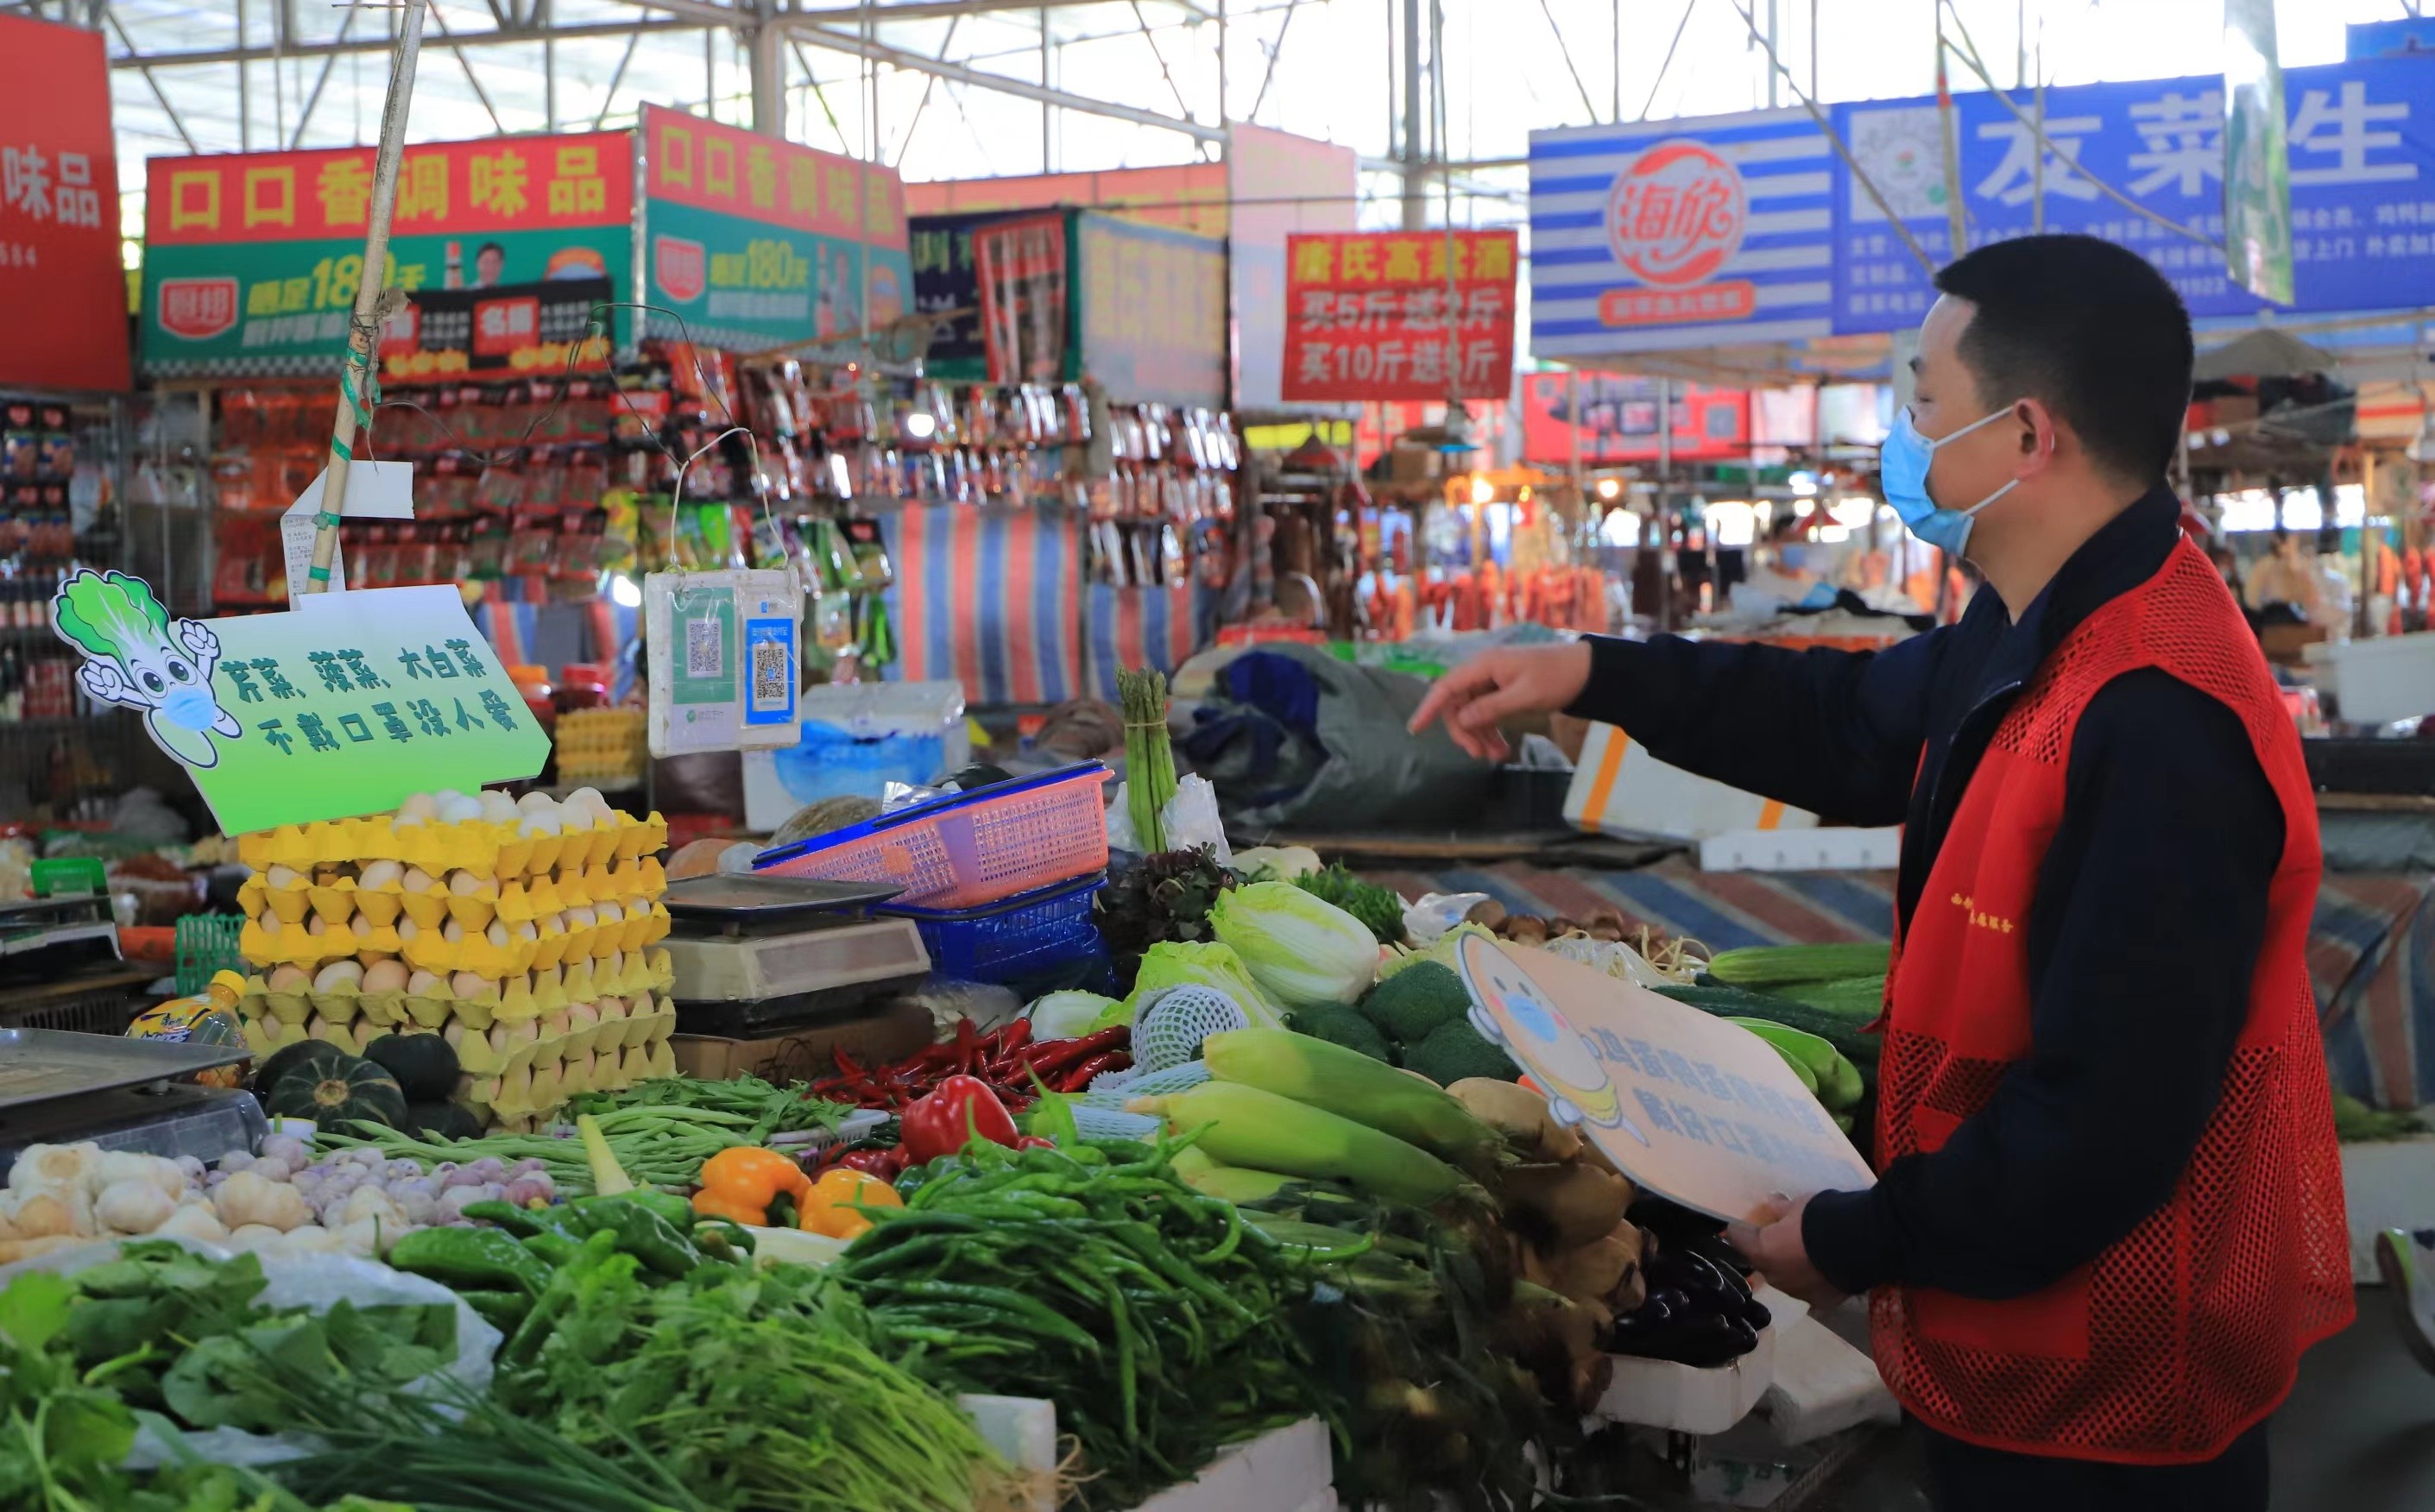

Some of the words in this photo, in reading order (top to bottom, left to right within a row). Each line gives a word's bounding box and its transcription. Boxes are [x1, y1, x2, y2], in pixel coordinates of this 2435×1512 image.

[171, 147, 604, 231] 口口香调味品
[1619, 177, 1733, 264] 海欣
[218, 638, 487, 704] 芹菜、菠菜、大白菜
[257, 688, 519, 756] 不戴口罩没人爱
